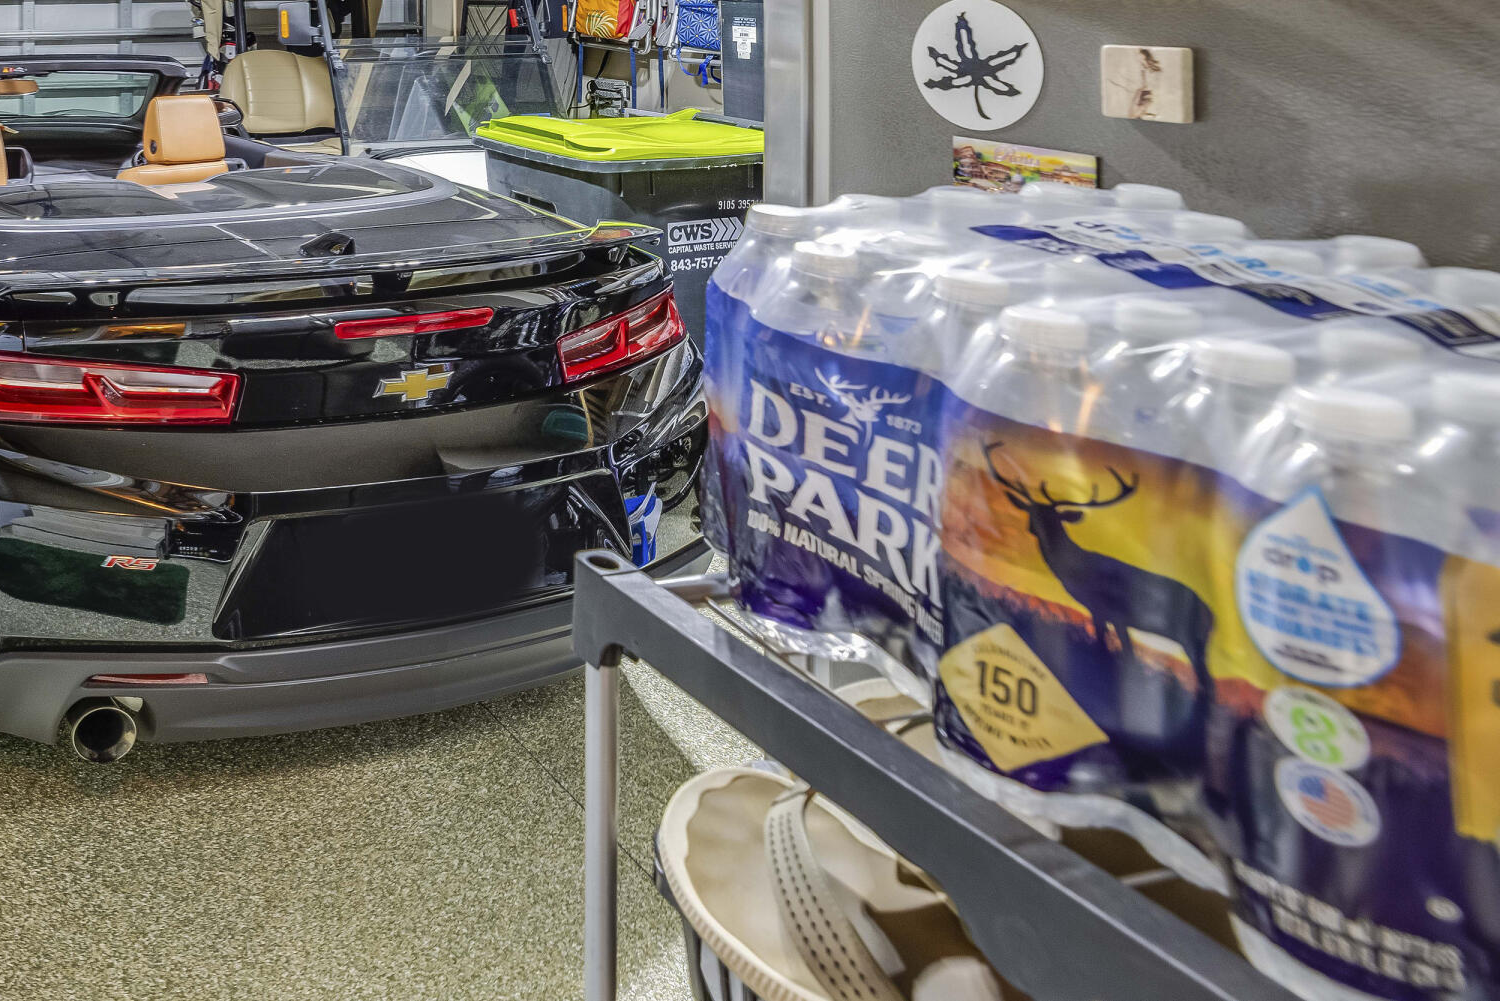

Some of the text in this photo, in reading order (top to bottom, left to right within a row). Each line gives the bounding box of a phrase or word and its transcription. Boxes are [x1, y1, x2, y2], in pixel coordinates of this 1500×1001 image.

[718, 199, 735, 211] 9105
[668, 222, 714, 243] CWS
[668, 244, 693, 255] CAPITAL
[692, 242, 715, 252] WASTE
[748, 378, 943, 530] DEER
[744, 439, 944, 611] PARK
[101, 555, 160, 571] RS
[783, 521, 862, 580] NATURAL
[862, 564, 916, 620] SPRING
[975, 659, 1039, 717] 150
